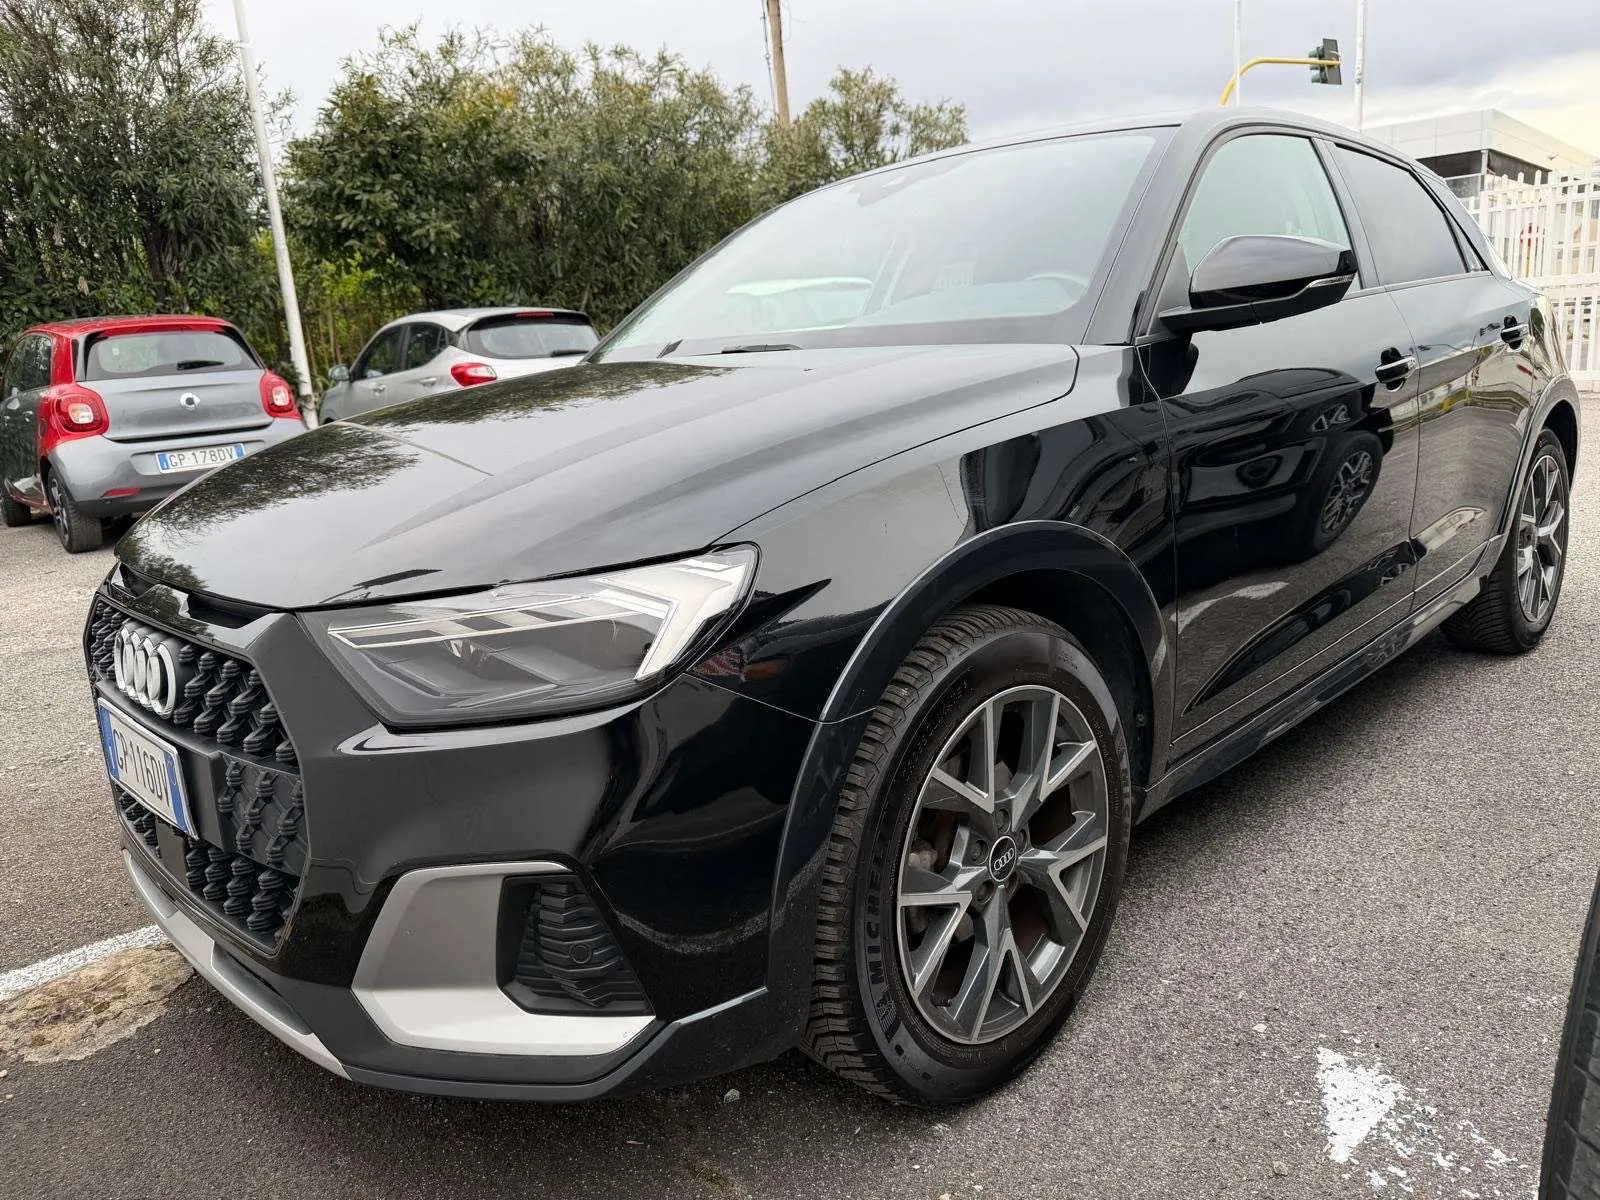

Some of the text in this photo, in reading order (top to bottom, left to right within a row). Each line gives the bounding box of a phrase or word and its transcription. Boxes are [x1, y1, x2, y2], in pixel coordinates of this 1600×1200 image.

[169, 453, 186, 467] GP
[192, 447, 233, 464] 178DV
[113, 728, 128, 774] GP
